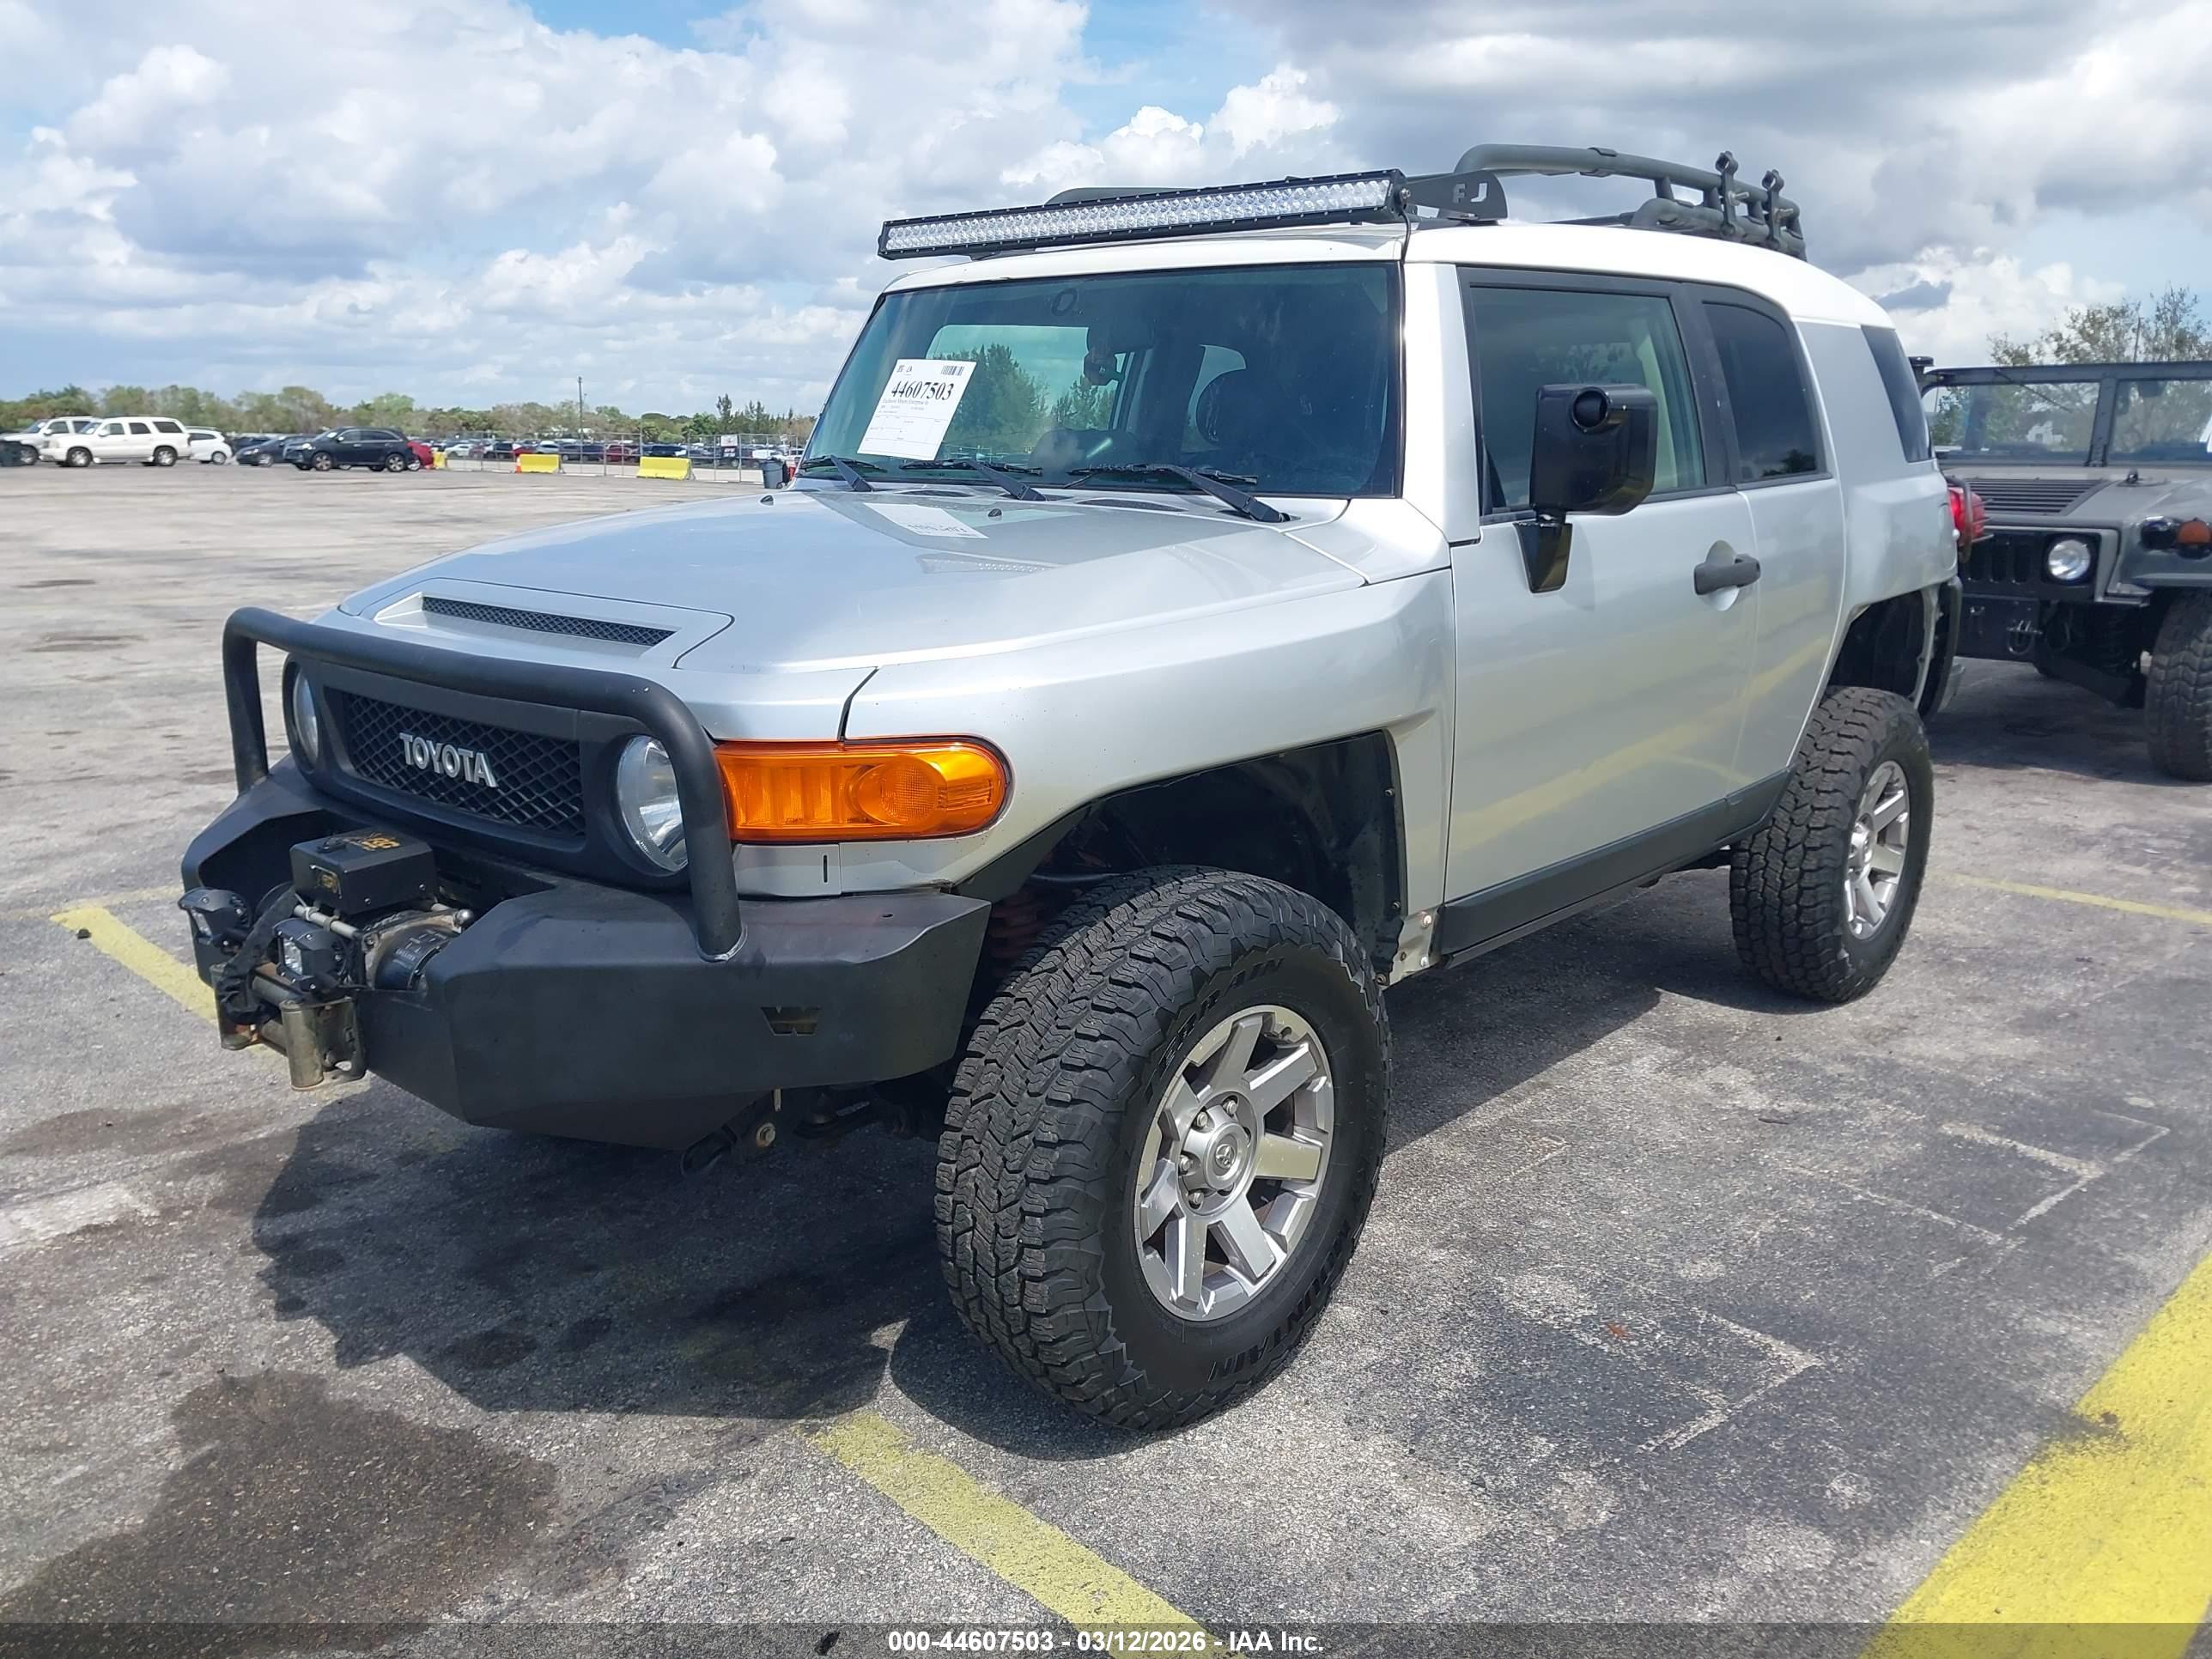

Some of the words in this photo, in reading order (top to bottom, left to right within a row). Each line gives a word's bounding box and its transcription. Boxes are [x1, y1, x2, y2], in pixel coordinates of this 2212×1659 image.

[1453, 182, 1488, 204] FJ
[891, 380, 954, 401] 44607503
[399, 732, 498, 788] TOYOTA
